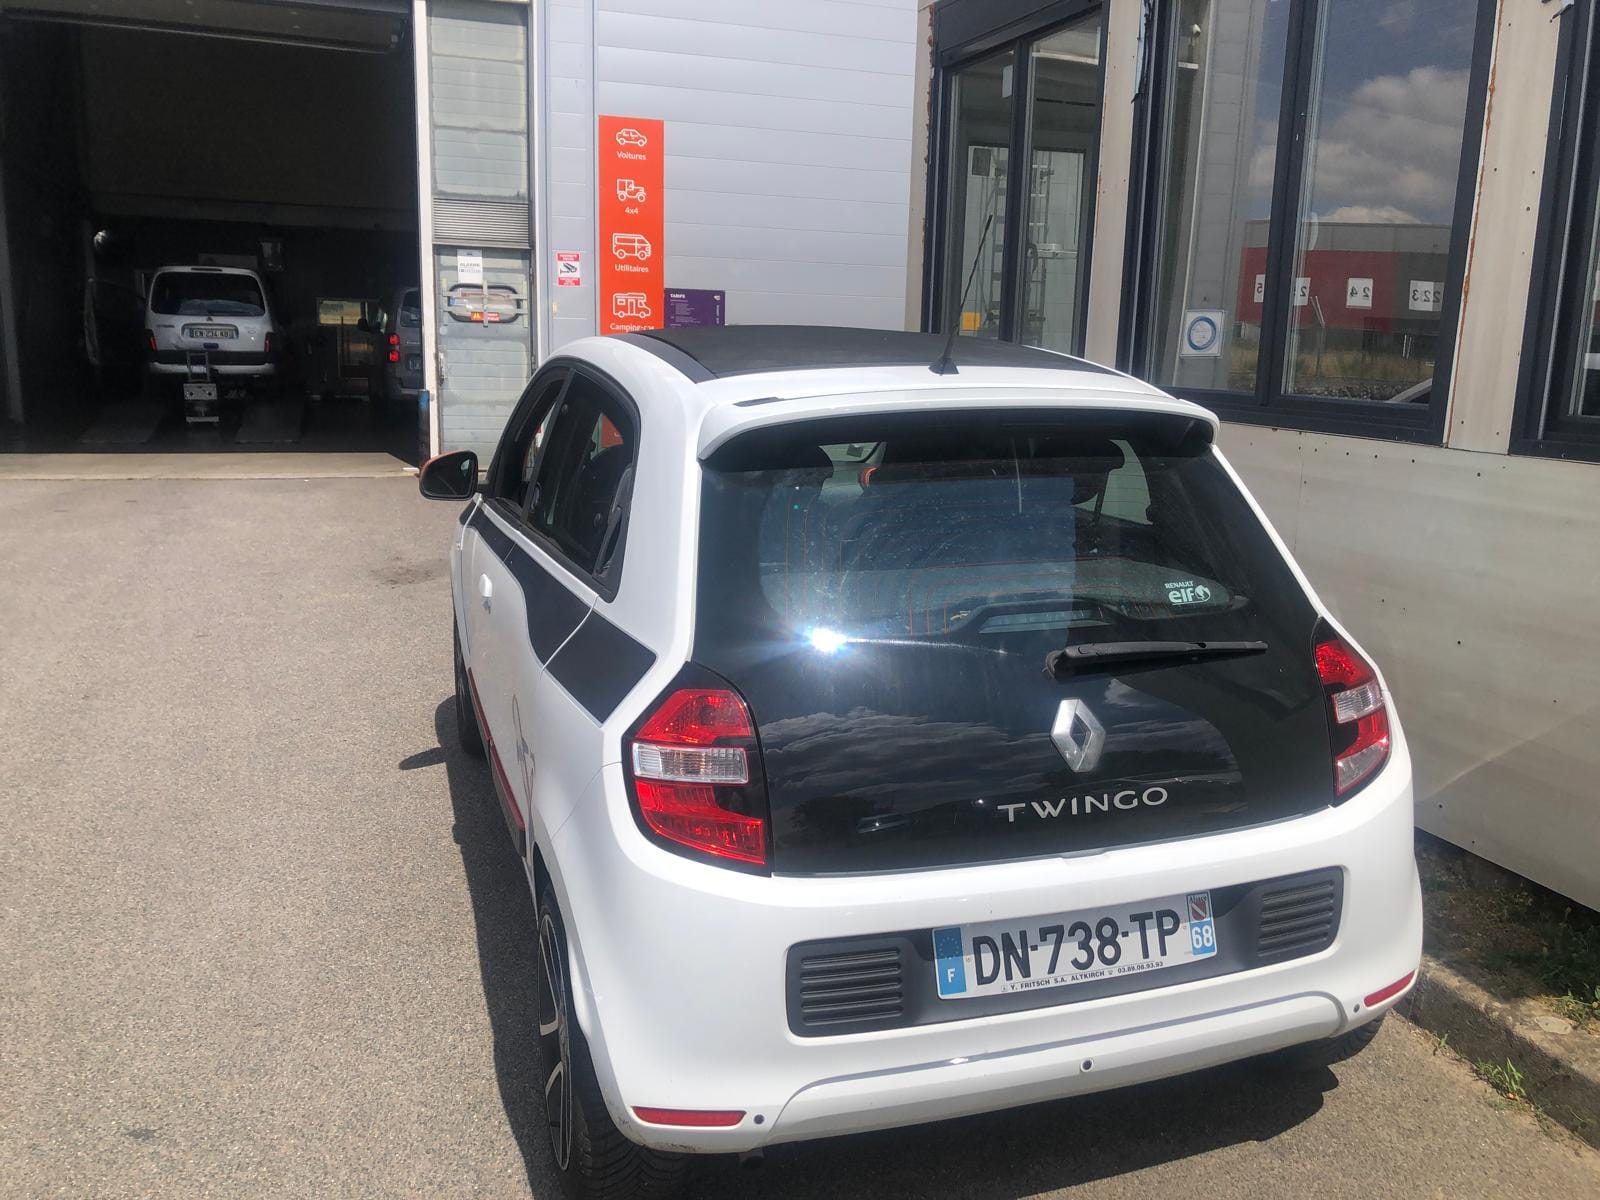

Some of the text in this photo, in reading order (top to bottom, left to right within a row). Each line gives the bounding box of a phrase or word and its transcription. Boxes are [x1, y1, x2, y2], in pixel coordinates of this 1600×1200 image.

[617, 151, 646, 160] Voitures
[625, 206, 639, 214] 4x4
[614, 264, 649, 273] Utilitaires
[1164, 580, 1194, 589] RENAULT
[1168, 587, 1195, 603] elf
[997, 787, 1168, 822] TWINGO
[946, 908, 1213, 986] F DN-738-TP 68
[1020, 979, 1051, 989] FRITSCH
[1054, 976, 1066, 985] S.A.
[1071, 970, 1105, 981] ALTKIRCH
